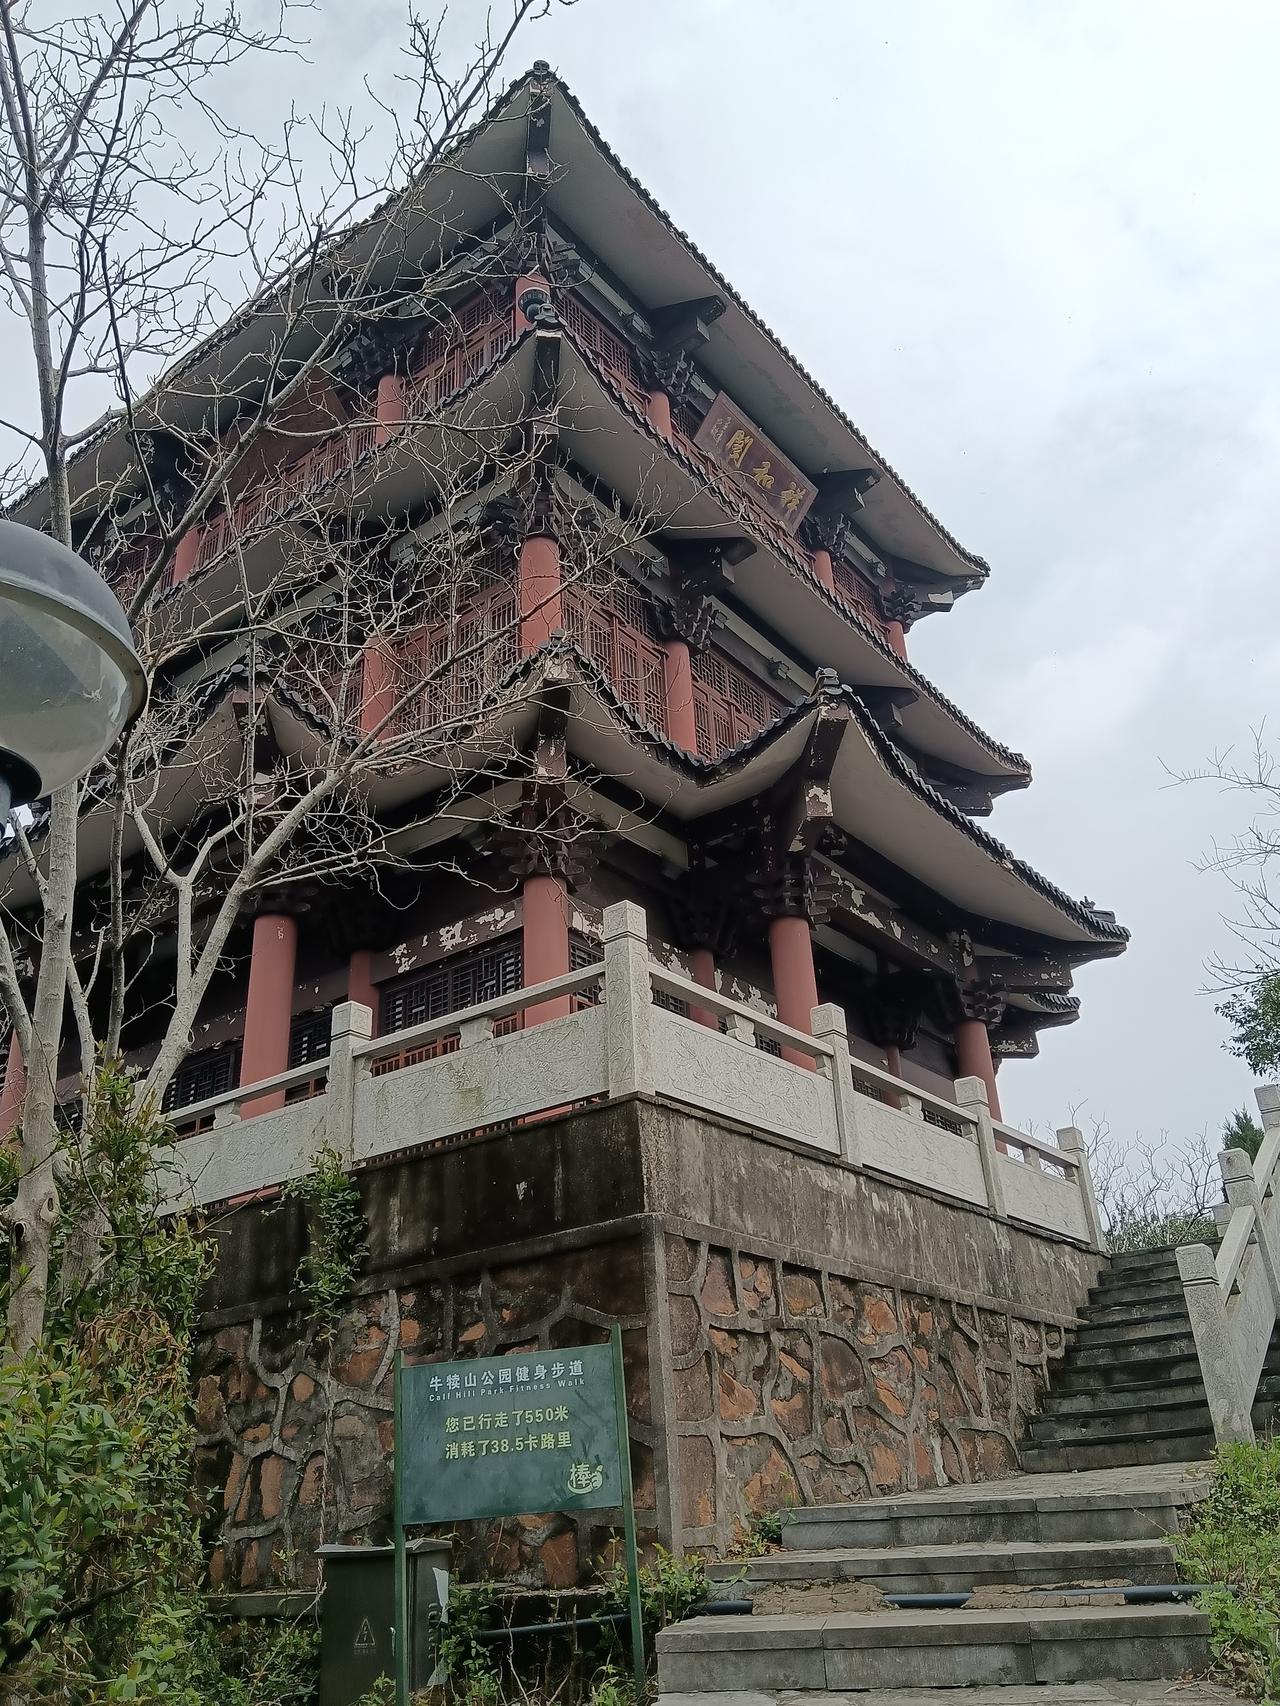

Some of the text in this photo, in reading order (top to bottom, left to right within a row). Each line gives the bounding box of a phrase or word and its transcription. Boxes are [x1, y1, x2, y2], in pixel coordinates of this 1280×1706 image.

[429, 1360, 583, 1391] 牛犊山公园健身步道
[456, 1390, 475, 1398] Hill
[481, 1387, 505, 1395] Park
[509, 1383, 551, 1392] Fitness
[557, 1378, 584, 1387] Walk
[445, 1405, 569, 1433] 您已行走了550米
[445, 1431, 572, 1459] 消耗了38.5卡路里
